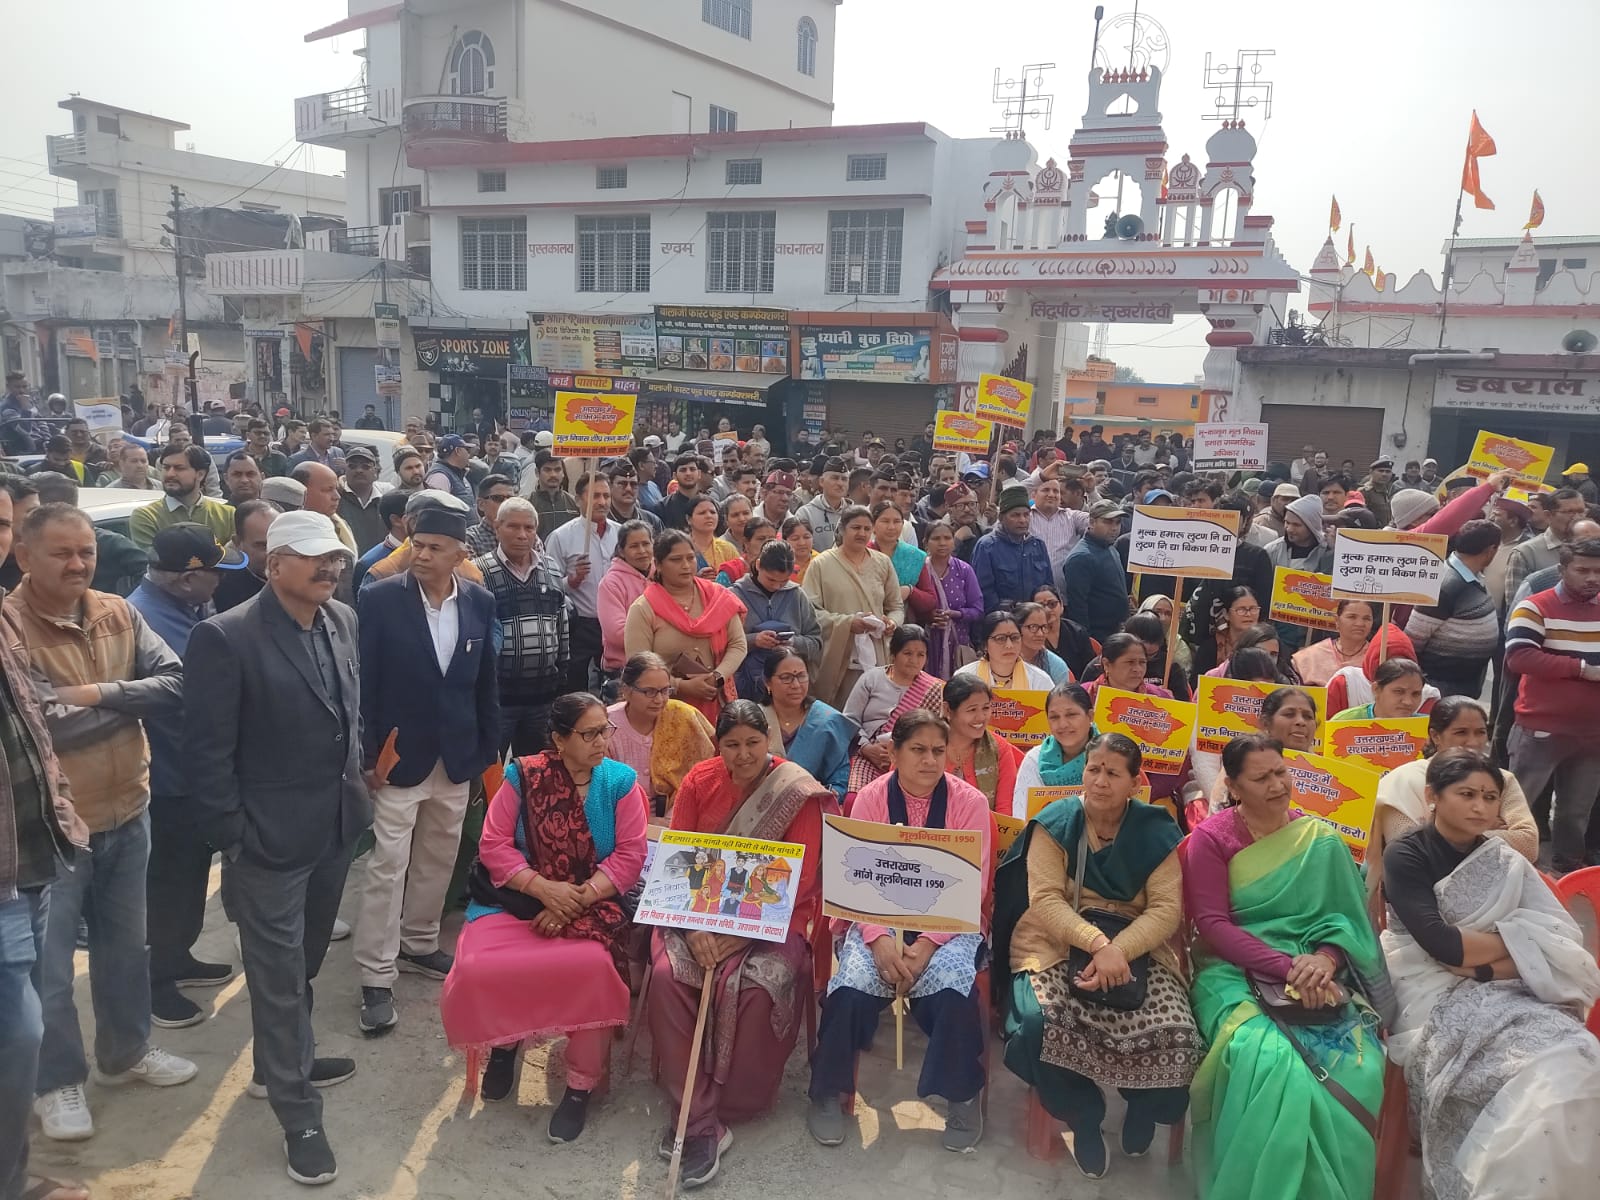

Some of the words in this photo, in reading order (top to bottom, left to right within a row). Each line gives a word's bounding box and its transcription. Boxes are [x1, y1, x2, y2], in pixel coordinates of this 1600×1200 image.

[528, 243, 575, 258] पुस्तकालय
[775, 243, 825, 256] वाचनालय
[818, 331, 853, 345] ध्यानी
[858, 333, 881, 348] बुक
[441, 340, 479, 353] SPORTS
[481, 341, 510, 354] ZONE
[552, 375, 569, 386] कार्ड
[577, 377, 609, 388] पासपोर्ट
[614, 379, 636, 391] वाहन
[1451, 374, 1588, 397] डबराल
[511, 410, 530, 418] ONLIN
[1137, 528, 1157, 539] मुल्क
[1210, 530, 1221, 541] नि
[1157, 540, 1167, 550] नि
[1209, 543, 1219, 554] नि
[1341, 553, 1365, 564] मुल्क
[1419, 556, 1429, 566] नि
[1365, 564, 1376, 575] नि
[1418, 569, 1428, 579] नि
[1232, 695, 1265, 706] उत्तराख
[1224, 703, 1252, 714] सशक्त
[1200, 726, 1217, 737] मूल
[1219, 726, 1241, 737] निवा
[1355, 734, 1394, 744] उत्तराखण्ड
[1395, 733, 1405, 742] में
[1152, 746, 1168, 758] लागू
[1347, 745, 1376, 754] सशक्त
[1377, 743, 1414, 756] भू-कानून
[1321, 774, 1332, 785] में
[1295, 780, 1339, 800] भू-कानून
[899, 830, 951, 843] मूलनिवास
[954, 835, 975, 843] 1950
[1340, 825, 1366, 840] करो।
[875, 858, 922, 873] उत्तराखण्ड
[853, 868, 873, 881] मांगे
[875, 873, 922, 887] मूलनिवास
[925, 879, 945, 889] 1950
